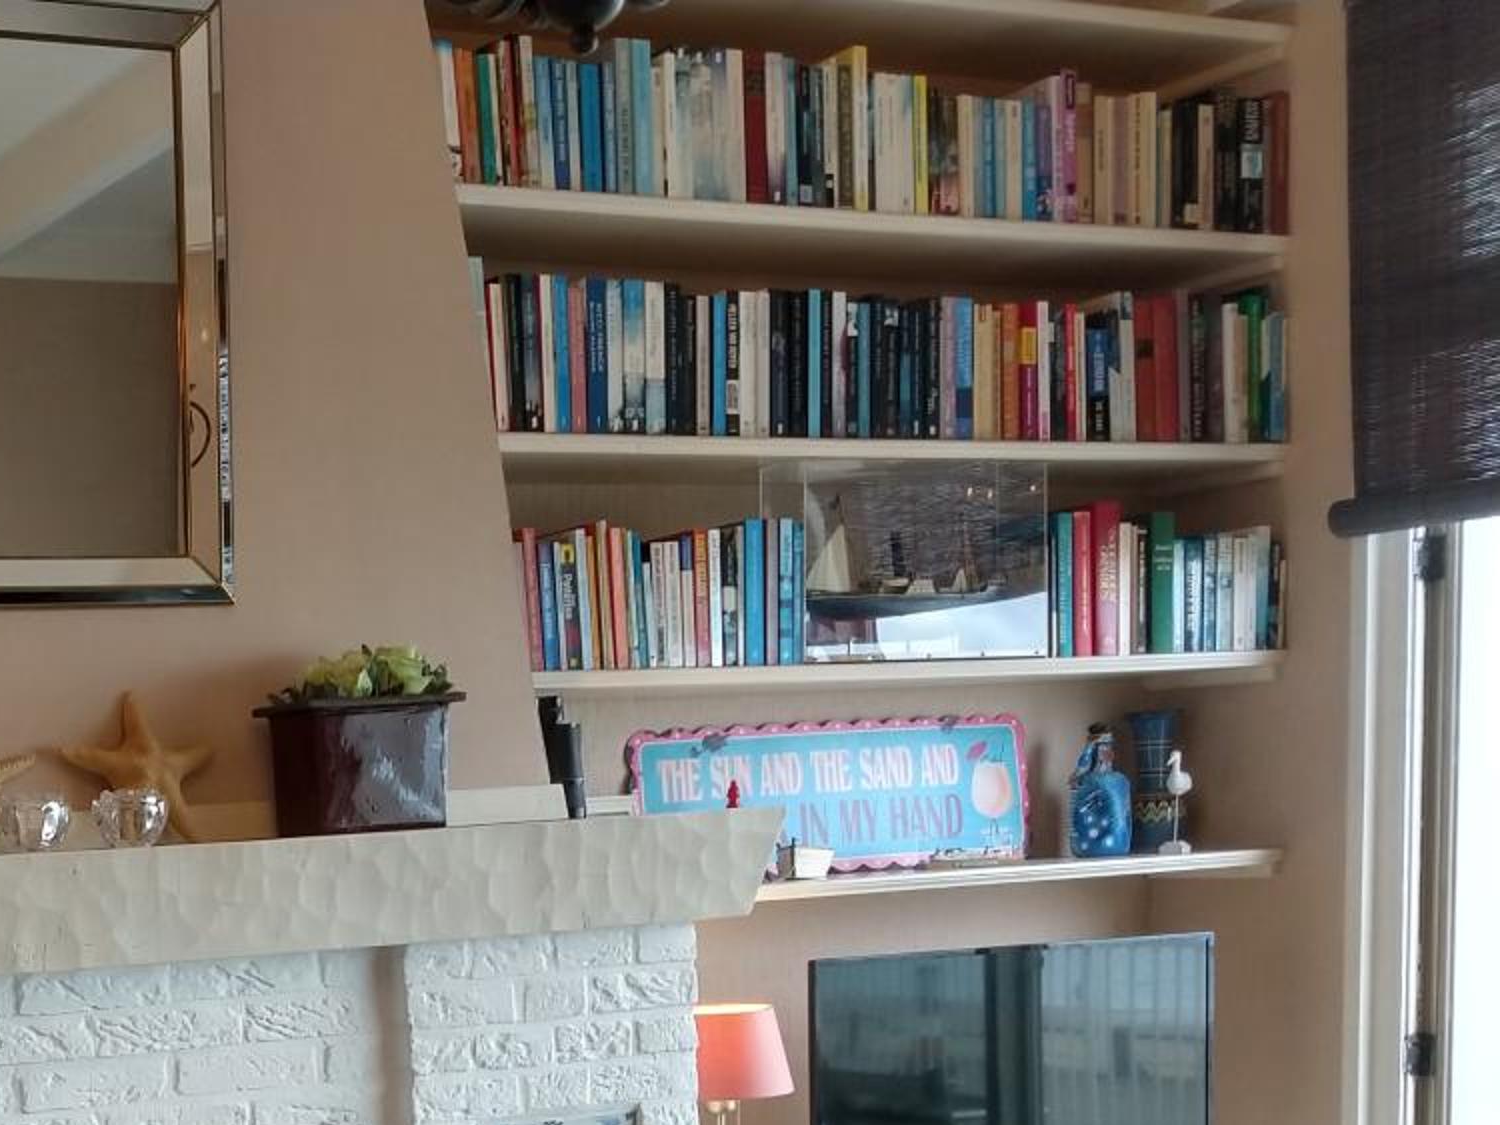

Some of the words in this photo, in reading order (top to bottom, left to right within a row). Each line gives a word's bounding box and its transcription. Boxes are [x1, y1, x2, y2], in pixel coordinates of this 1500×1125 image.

[656, 757, 702, 804] THE
[760, 751, 802, 797] AND
[809, 750, 854, 794] THE
[861, 746, 914, 791] SAND
[920, 744, 960, 787] AND
[799, 804, 829, 847] IN
[839, 799, 879, 844] MY
[889, 794, 964, 841] HAND
